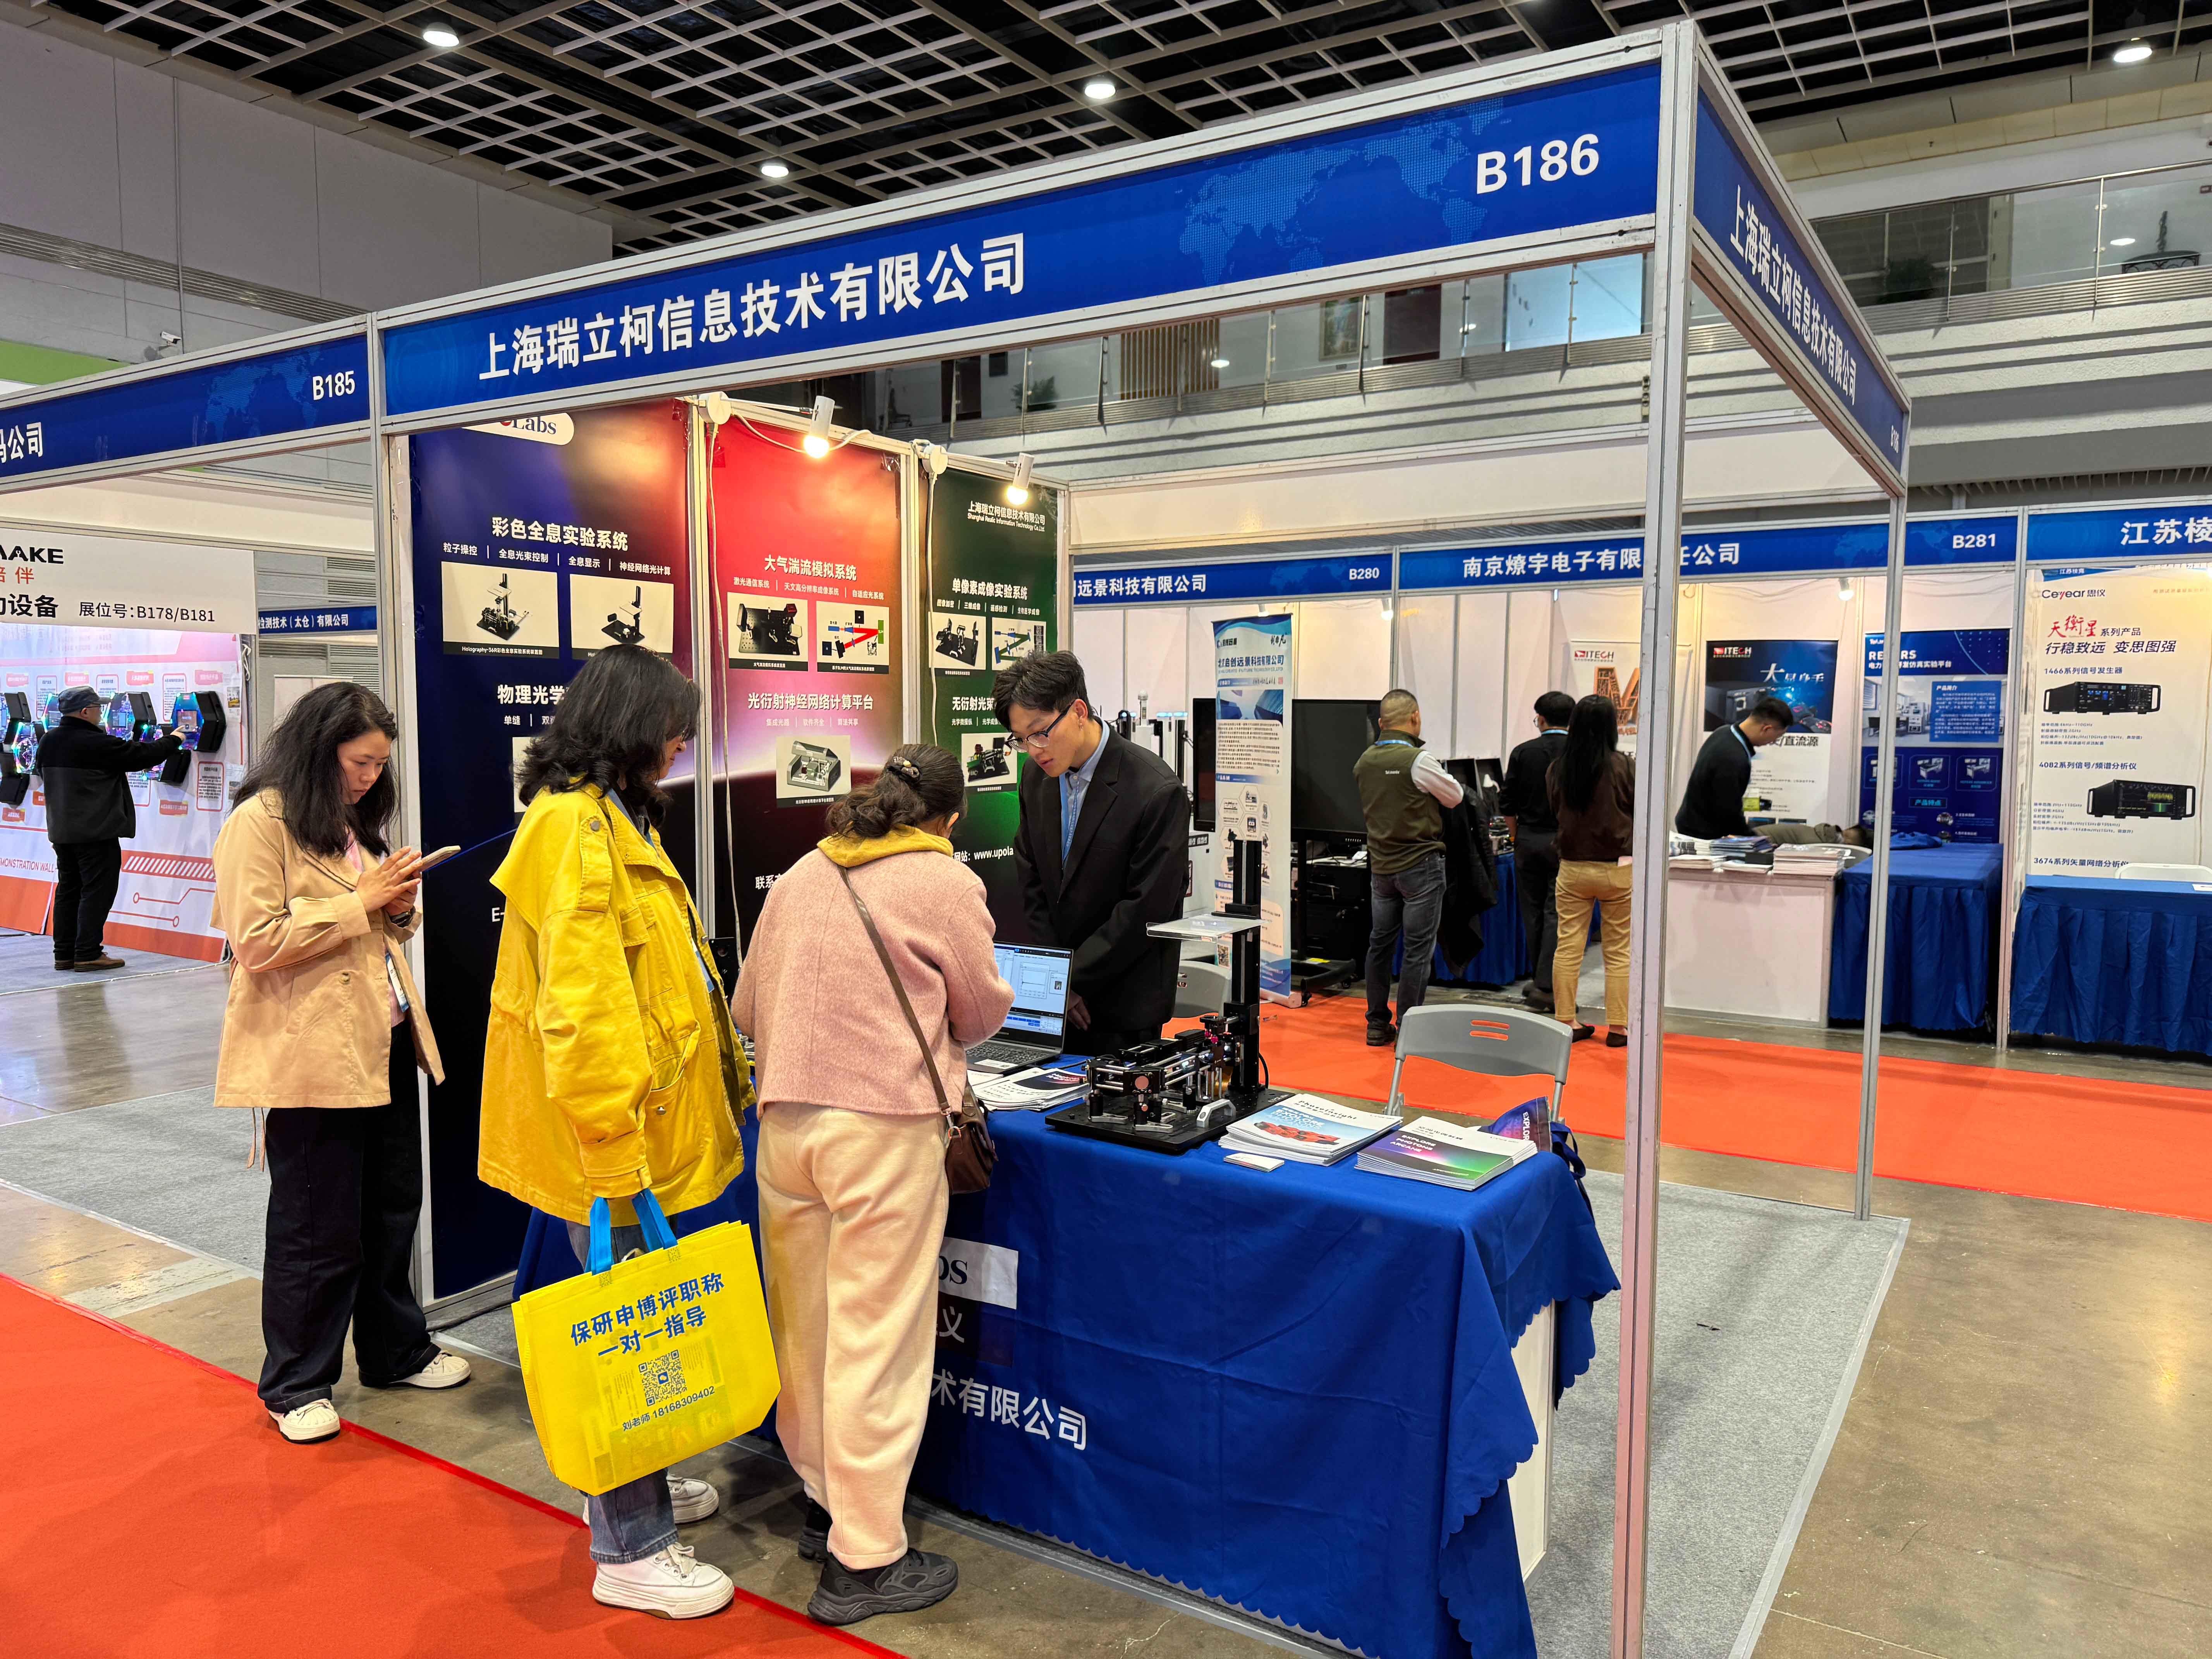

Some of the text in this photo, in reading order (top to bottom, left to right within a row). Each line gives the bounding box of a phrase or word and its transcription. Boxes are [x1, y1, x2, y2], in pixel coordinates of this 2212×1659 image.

[1477, 133, 1599, 194] B186
[1730, 184, 1856, 406] 上海瑞立柯信息技术有限公司
[479, 232, 1025, 380] 上海瑞立柯信息技术有限公司
[312, 370, 355, 400] B185
[967, 512, 985, 522] Shanghai
[968, 500, 1045, 526] 上海瑞立柯信息技术有限公司
[492, 516, 629, 551] 彩色全息实验系统
[1952, 533, 1996, 549] B281
[443, 542, 671, 576] 粒子操控 全息光束控制 全息显示 神经网络光计算
[764, 554, 857, 581] 大气湍流模拟系统
[733, 576, 770, 589] 激光通信系统
[1349, 567, 1380, 580] B280
[951, 577, 1028, 600] 单像素成像实验系统
[1073, 574, 1207, 598] 远景科技有限公司
[2042, 590, 2086, 600] Ceyear
[79, 601, 215, 622] 展位号:B178/B181
[2047, 615, 2141, 638] 天衡星 系列产品
[1586, 651, 1614, 659] ITECH
[1724, 647, 1752, 655] ITECH
[2045, 640, 2177, 655] 行稳致远 变思图强
[748, 692, 874, 710] 光衍射神经网络计算平台
[952, 696, 997, 711] 无衍射光束
[503, 715, 520, 725] 单缝
[2039, 761, 2137, 770] 4082系列信号/频谱分析仪
[1390, 1141, 1422, 1152] ARCANE
[1396, 1137, 1433, 1151] PHOTONS
[1401, 1134, 1436, 1147] EXPLORE
[570, 1272, 725, 1346] 保研申博评职称
[598, 1305, 707, 1357] 一对一指导
[622, 1386, 715, 1431] 刘老师 18168309402
[931, 1369, 1086, 1450] 术有限公司
